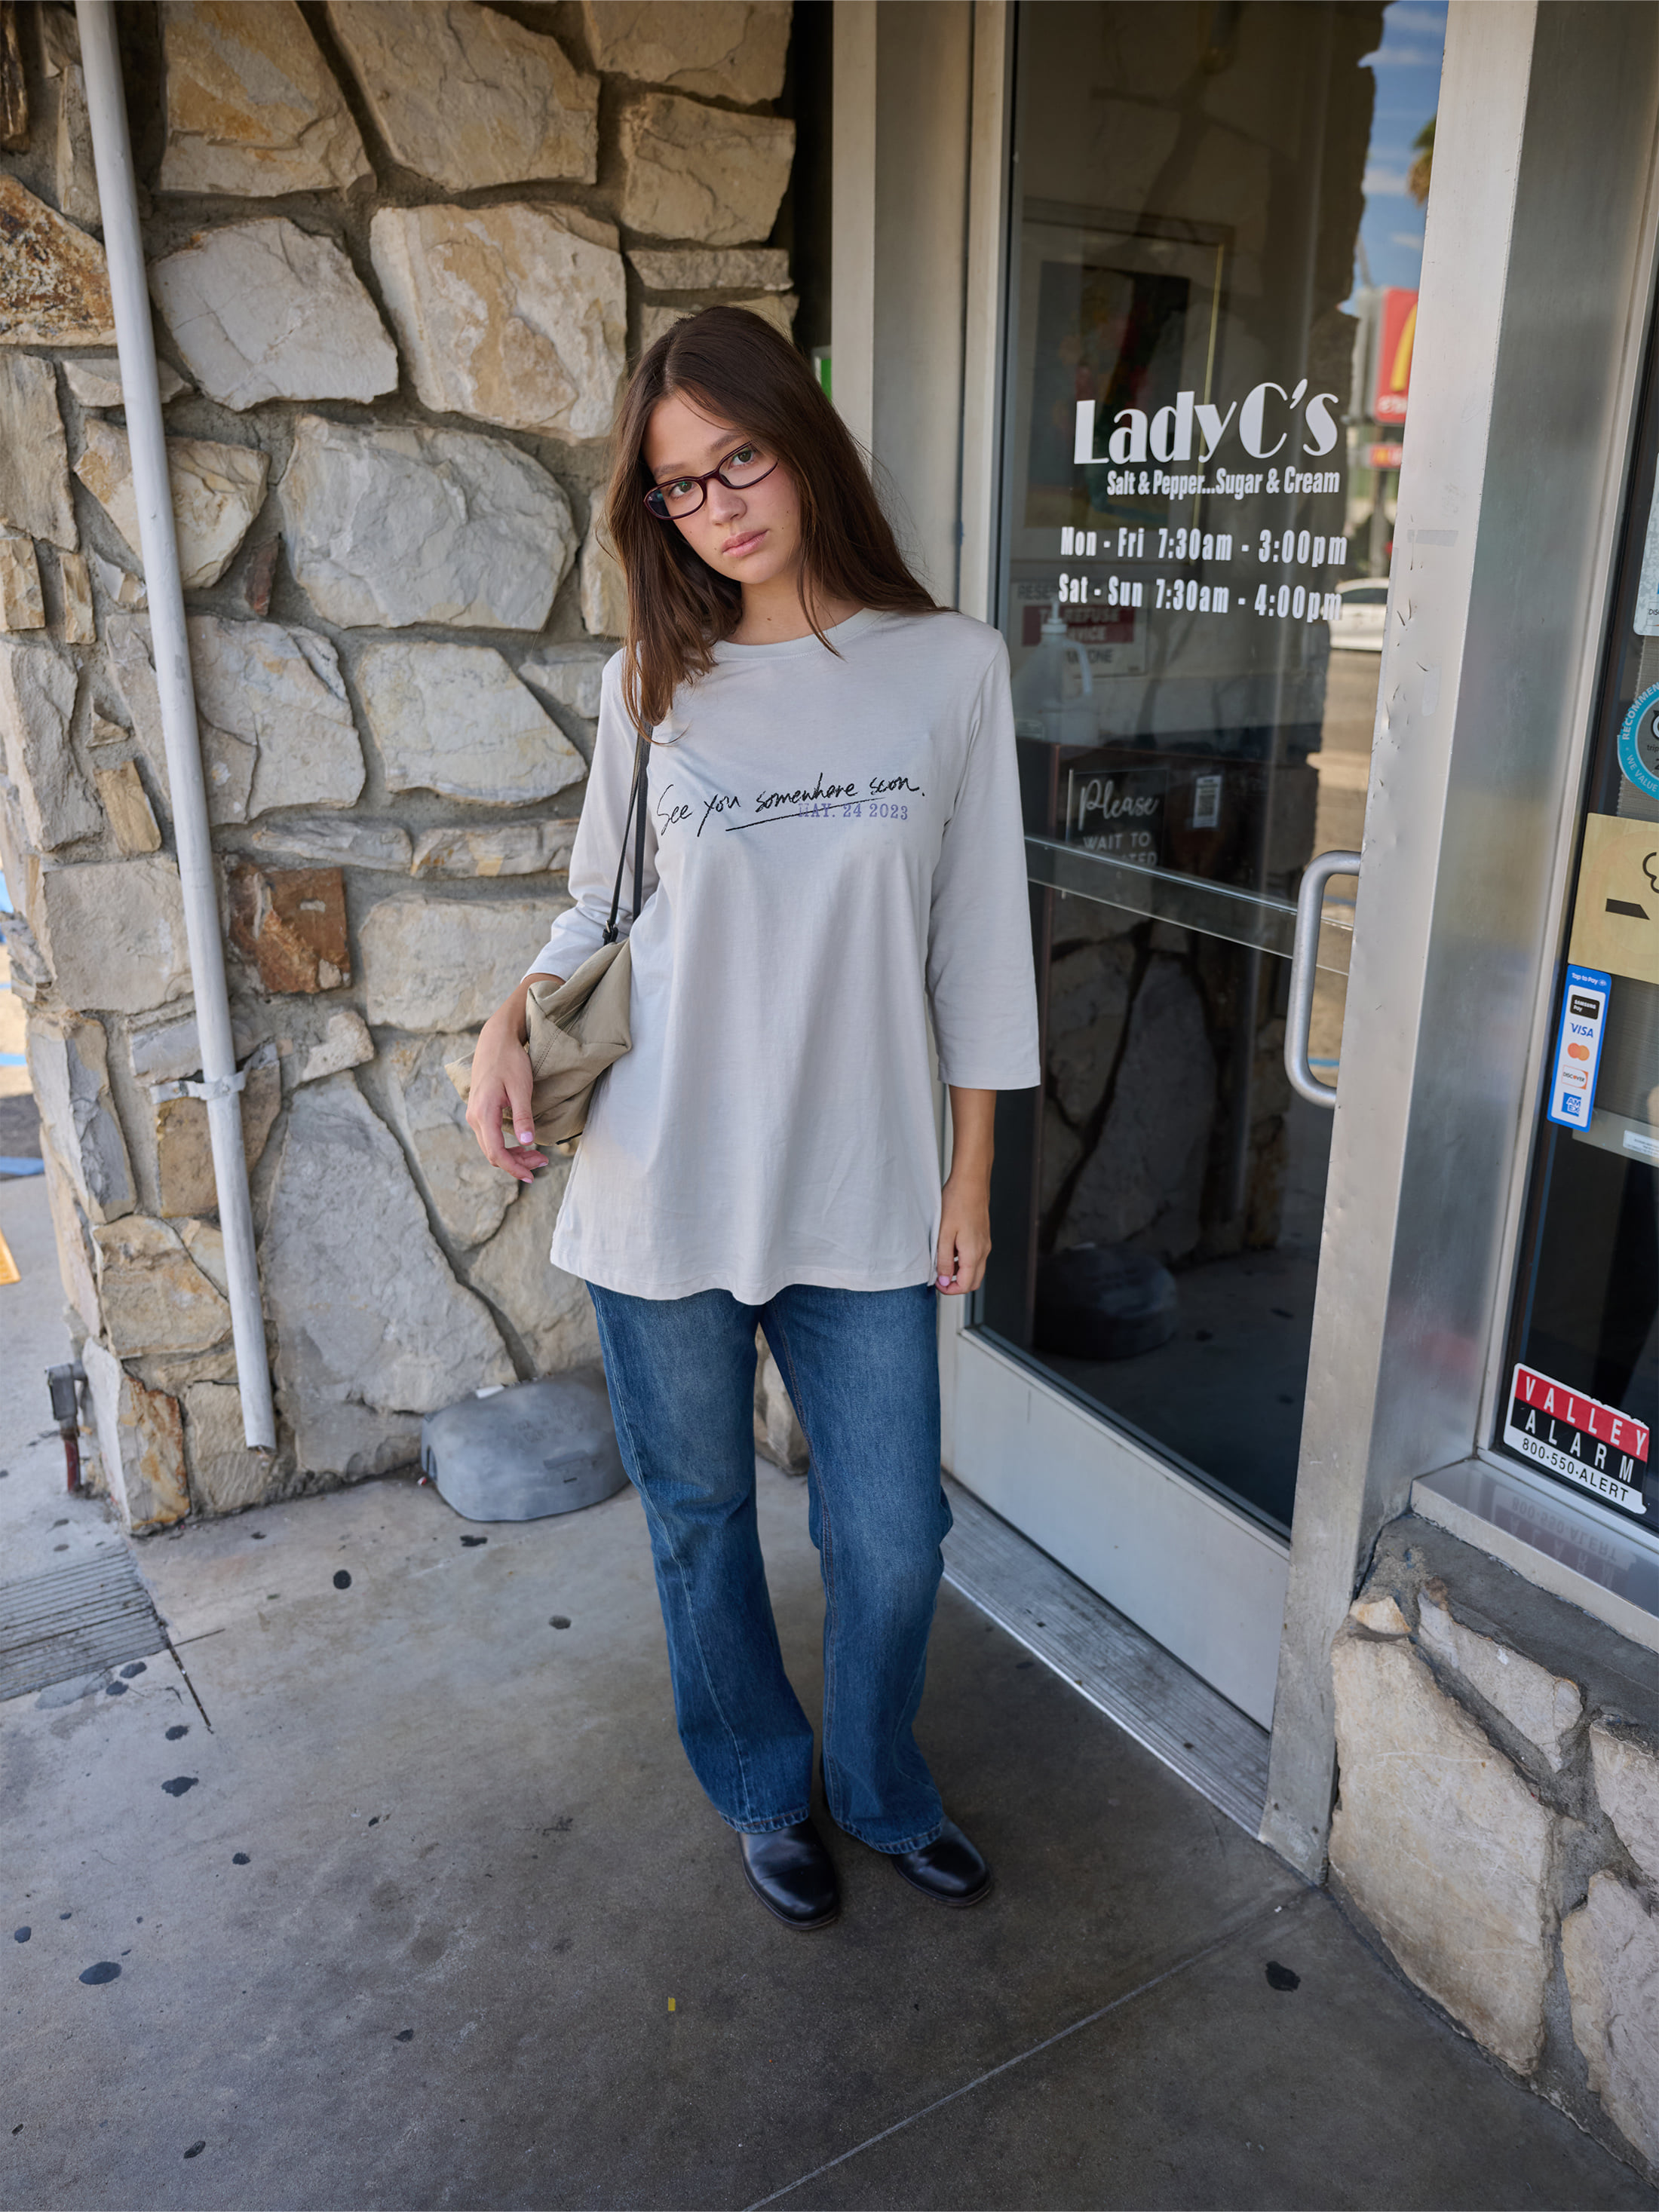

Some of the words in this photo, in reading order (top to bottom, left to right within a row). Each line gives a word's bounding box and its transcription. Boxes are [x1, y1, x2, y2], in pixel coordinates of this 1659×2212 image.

[1107, 470, 1136, 495] Salt
[1138, 470, 1150, 495] &
[1266, 467, 1280, 494] &
[1283, 466, 1340, 494] Cream
[1061, 526, 1096, 556] Mon
[1118, 527, 1145, 558] Fri
[1158, 528, 1233, 561] 7:30am
[1259, 529, 1348, 567] 3:00pm
[1059, 573, 1088, 604] Sat
[1108, 575, 1143, 607] Sun
[1156, 578, 1229, 613] 7:30am
[1255, 584, 1342, 623] 4:00pm
[1627, 754, 1637, 771] WE
[1635, 769, 1658, 792] VALUE
[656, 784, 693, 835] See
[697, 793, 741, 837] you
[843, 802, 862, 818] 24
[869, 803, 909, 820] 2023
[1078, 779, 1160, 832] Please
[1083, 833, 1124, 850] WAIT
[1130, 830, 1152, 848] TO
[1572, 973, 1581, 981] Tap
[1587, 976, 1599, 985] Pay
[1570, 1022, 1593, 1038] VISA
[1526, 1376, 1647, 1456] VALLEY
[1525, 1409, 1635, 1483] ALARM
